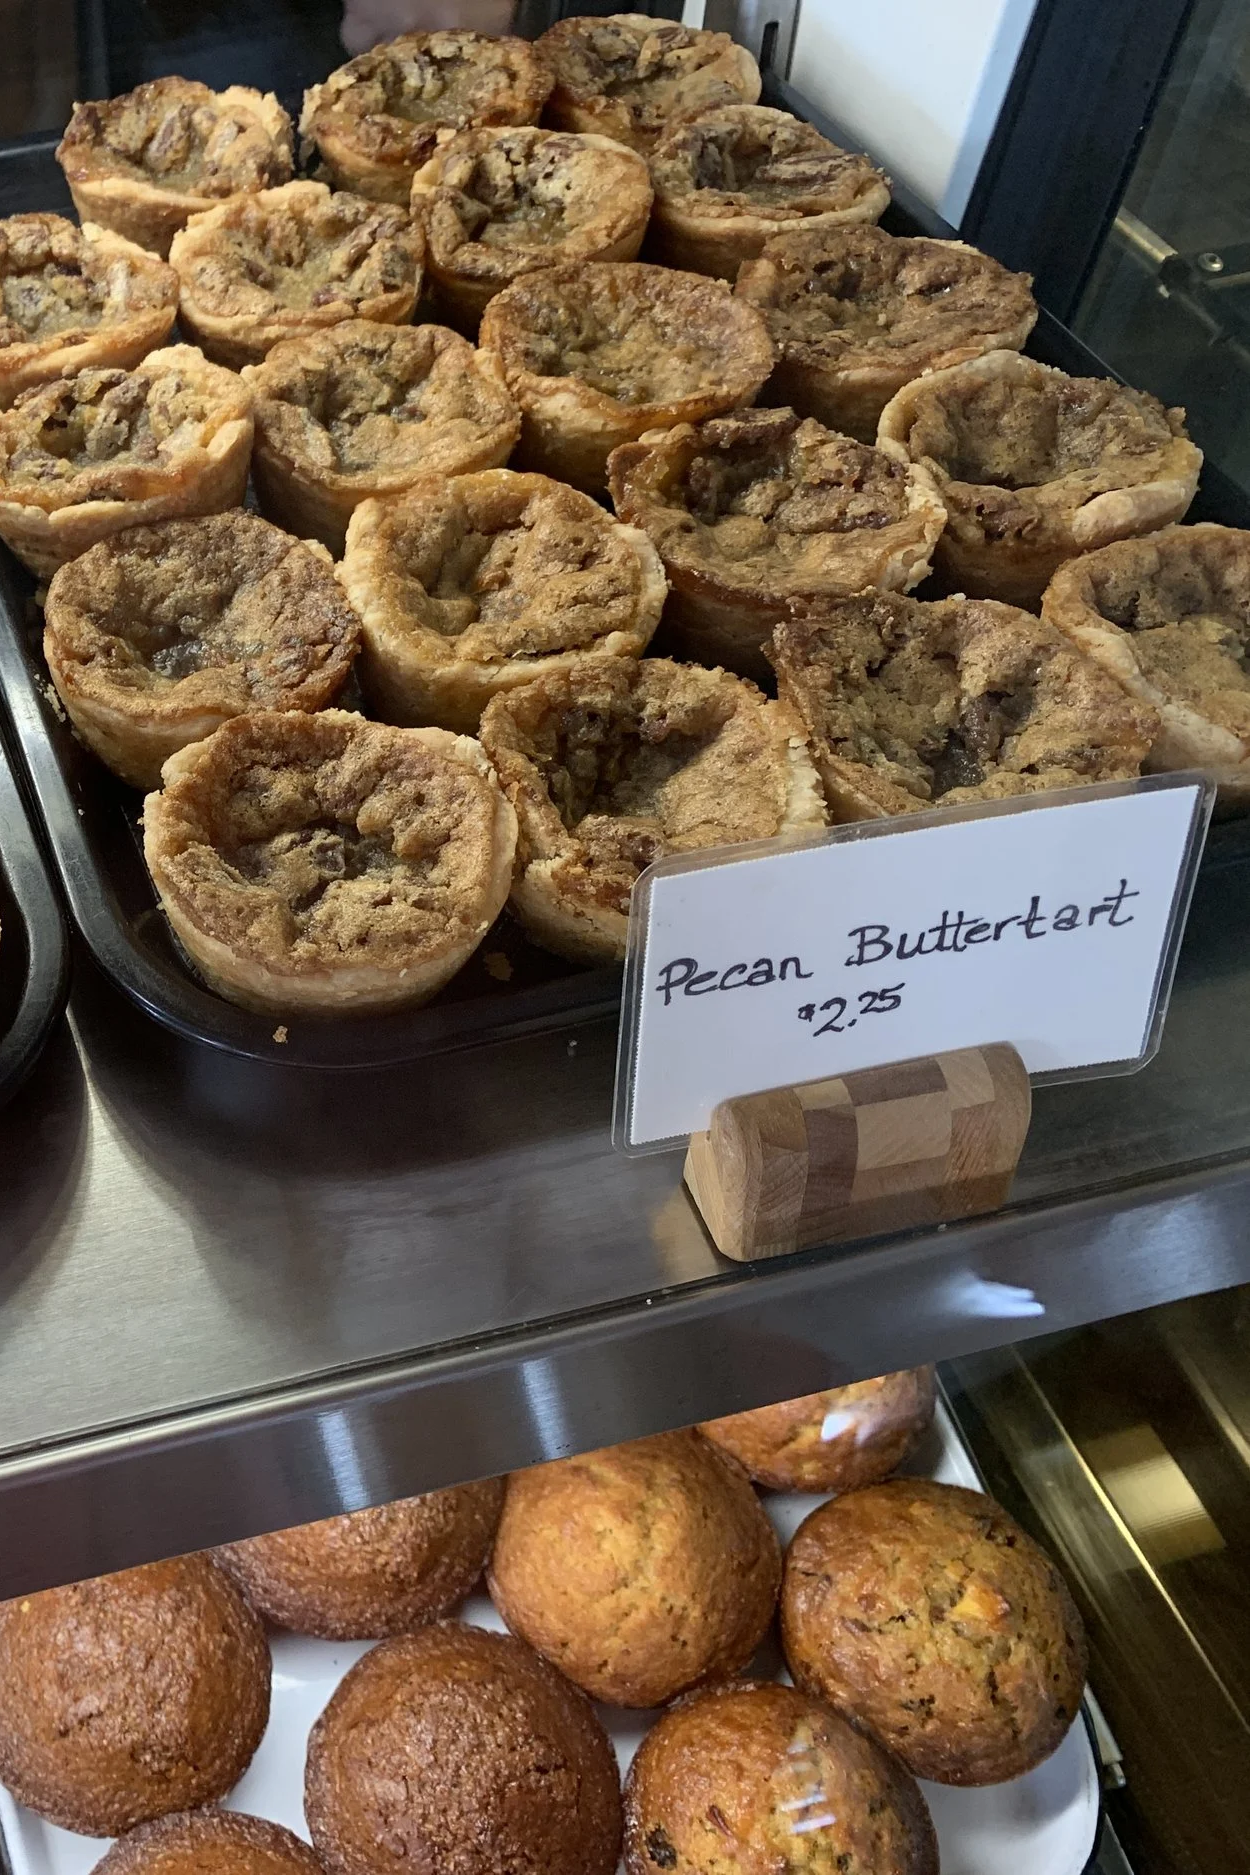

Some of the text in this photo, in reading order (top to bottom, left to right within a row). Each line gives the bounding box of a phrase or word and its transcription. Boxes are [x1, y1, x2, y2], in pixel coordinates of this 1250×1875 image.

[656, 878, 1141, 1006] Pecan Buttertart
[798, 982, 906, 1037] $2.25
